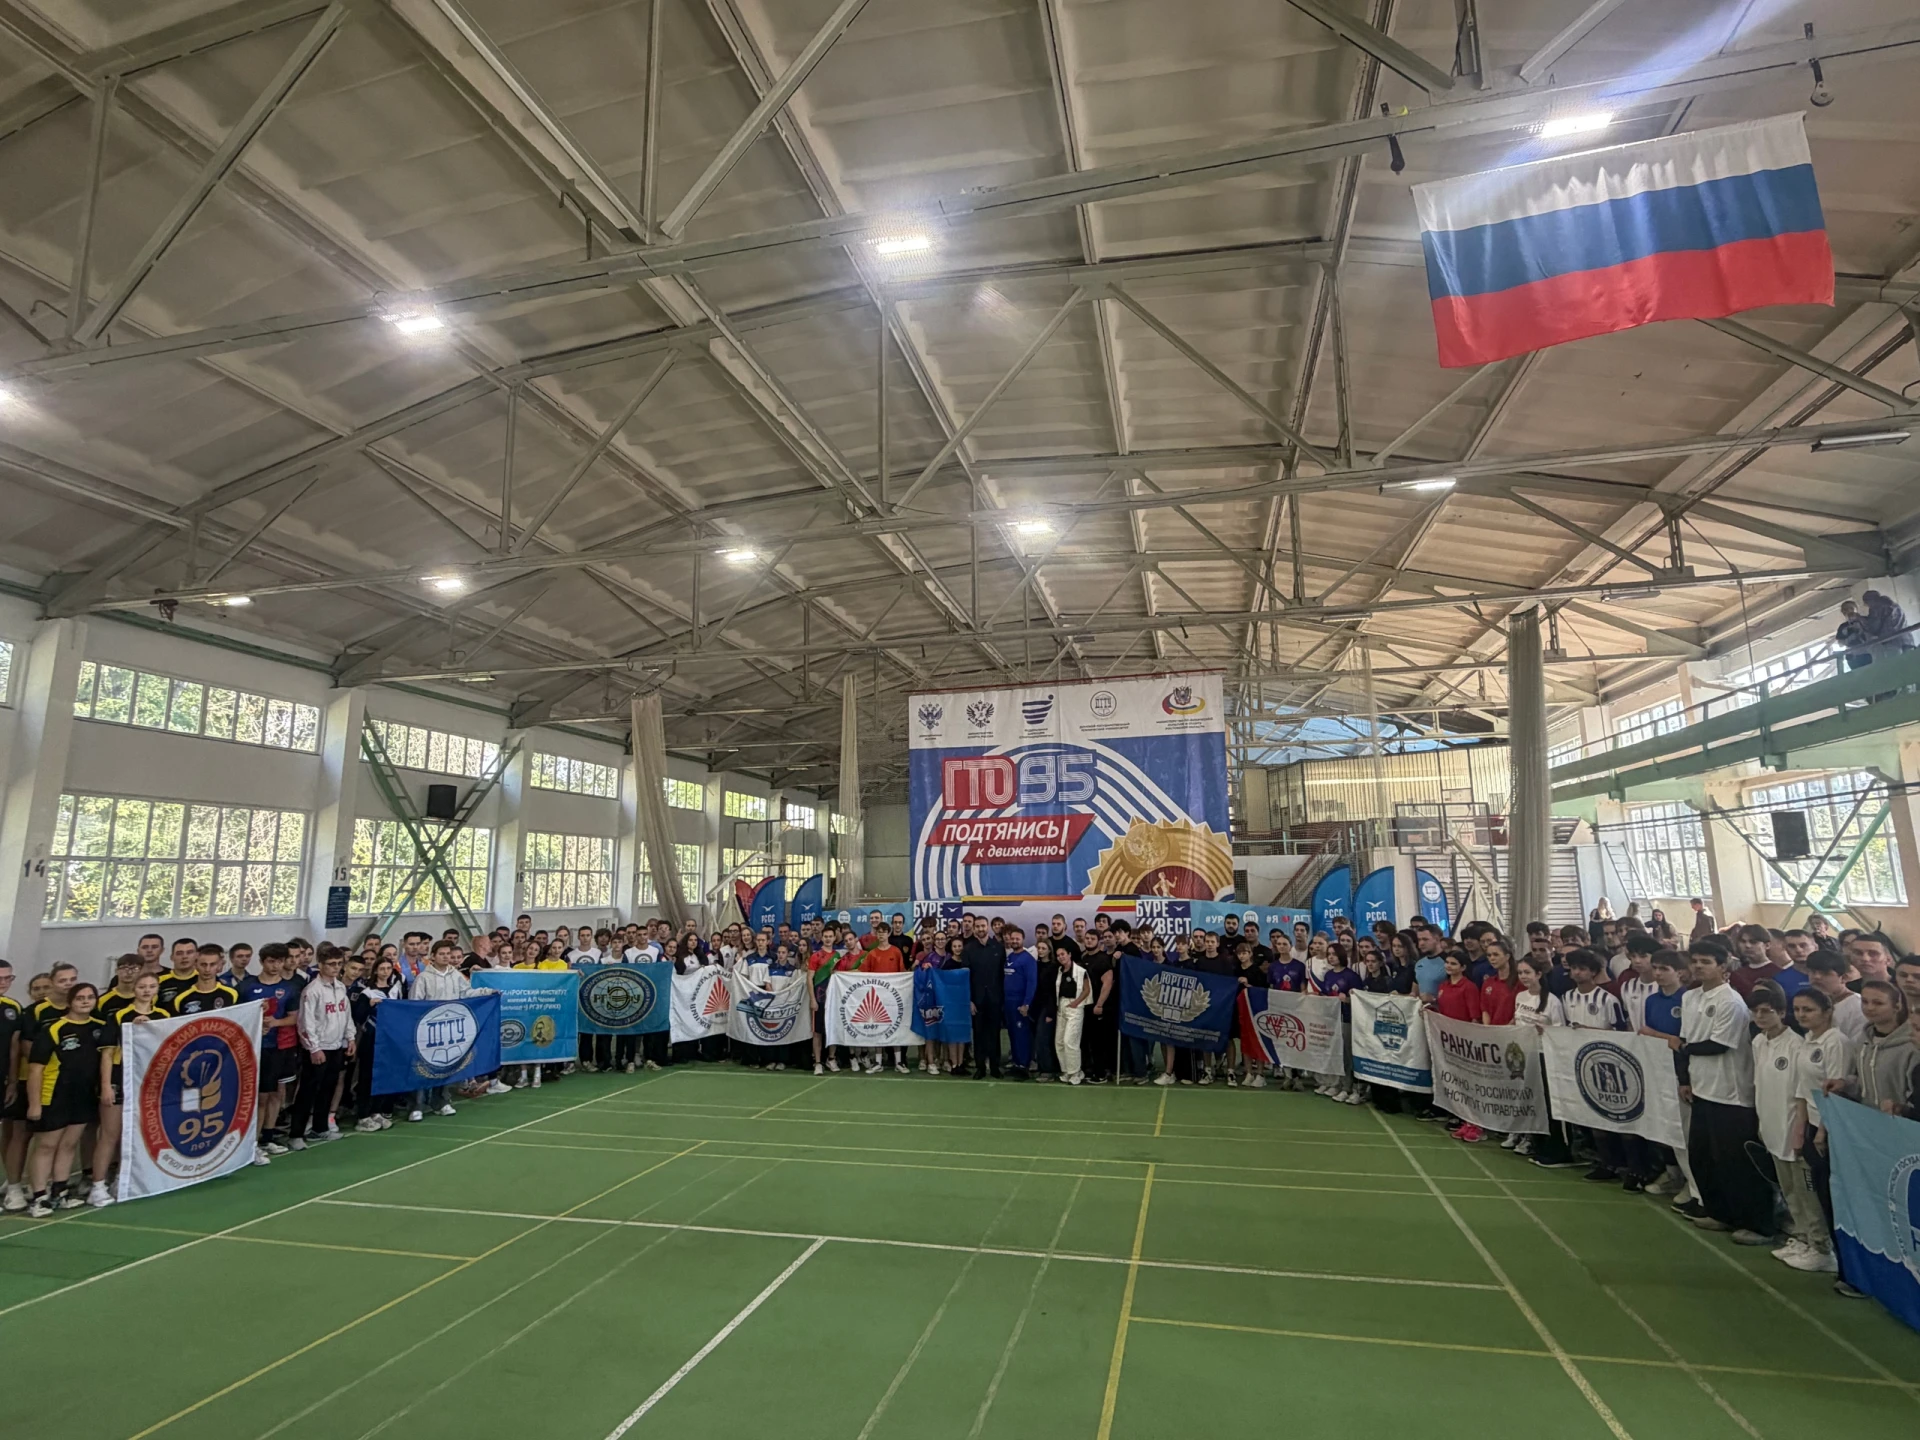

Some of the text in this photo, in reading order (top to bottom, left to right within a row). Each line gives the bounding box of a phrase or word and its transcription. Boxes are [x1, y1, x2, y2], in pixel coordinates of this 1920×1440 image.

[945, 754, 1095, 806] ГТО 95
[335, 867, 347, 881] 15
[913, 902, 944, 918] БУРЕ
[1136, 901, 1169, 917] БУРЕ
[1157, 918, 1191, 934] ВЕСТ
[841, 979, 890, 1005] ФЕДЕРАЛЬНЫЙ
[1161, 973, 1196, 990] ЮРГПУ
[1158, 984, 1193, 1009] НПИ
[763, 1002, 802, 1019] РГУПС
[885, 987, 904, 1039] УНИВЕРСИТЕТ
[426, 1018, 466, 1048] ДГТУ
[750, 1020, 792, 1039] РОСТОВ-НА-ДОНУ
[840, 1007, 858, 1039] ЮЖНЫЙ
[1286, 1029, 1306, 1052] 30
[1441, 1030, 1502, 1064] РАНХиГС
[1598, 1092, 1628, 1104] РИЗП
[178, 1111, 225, 1145] 95
